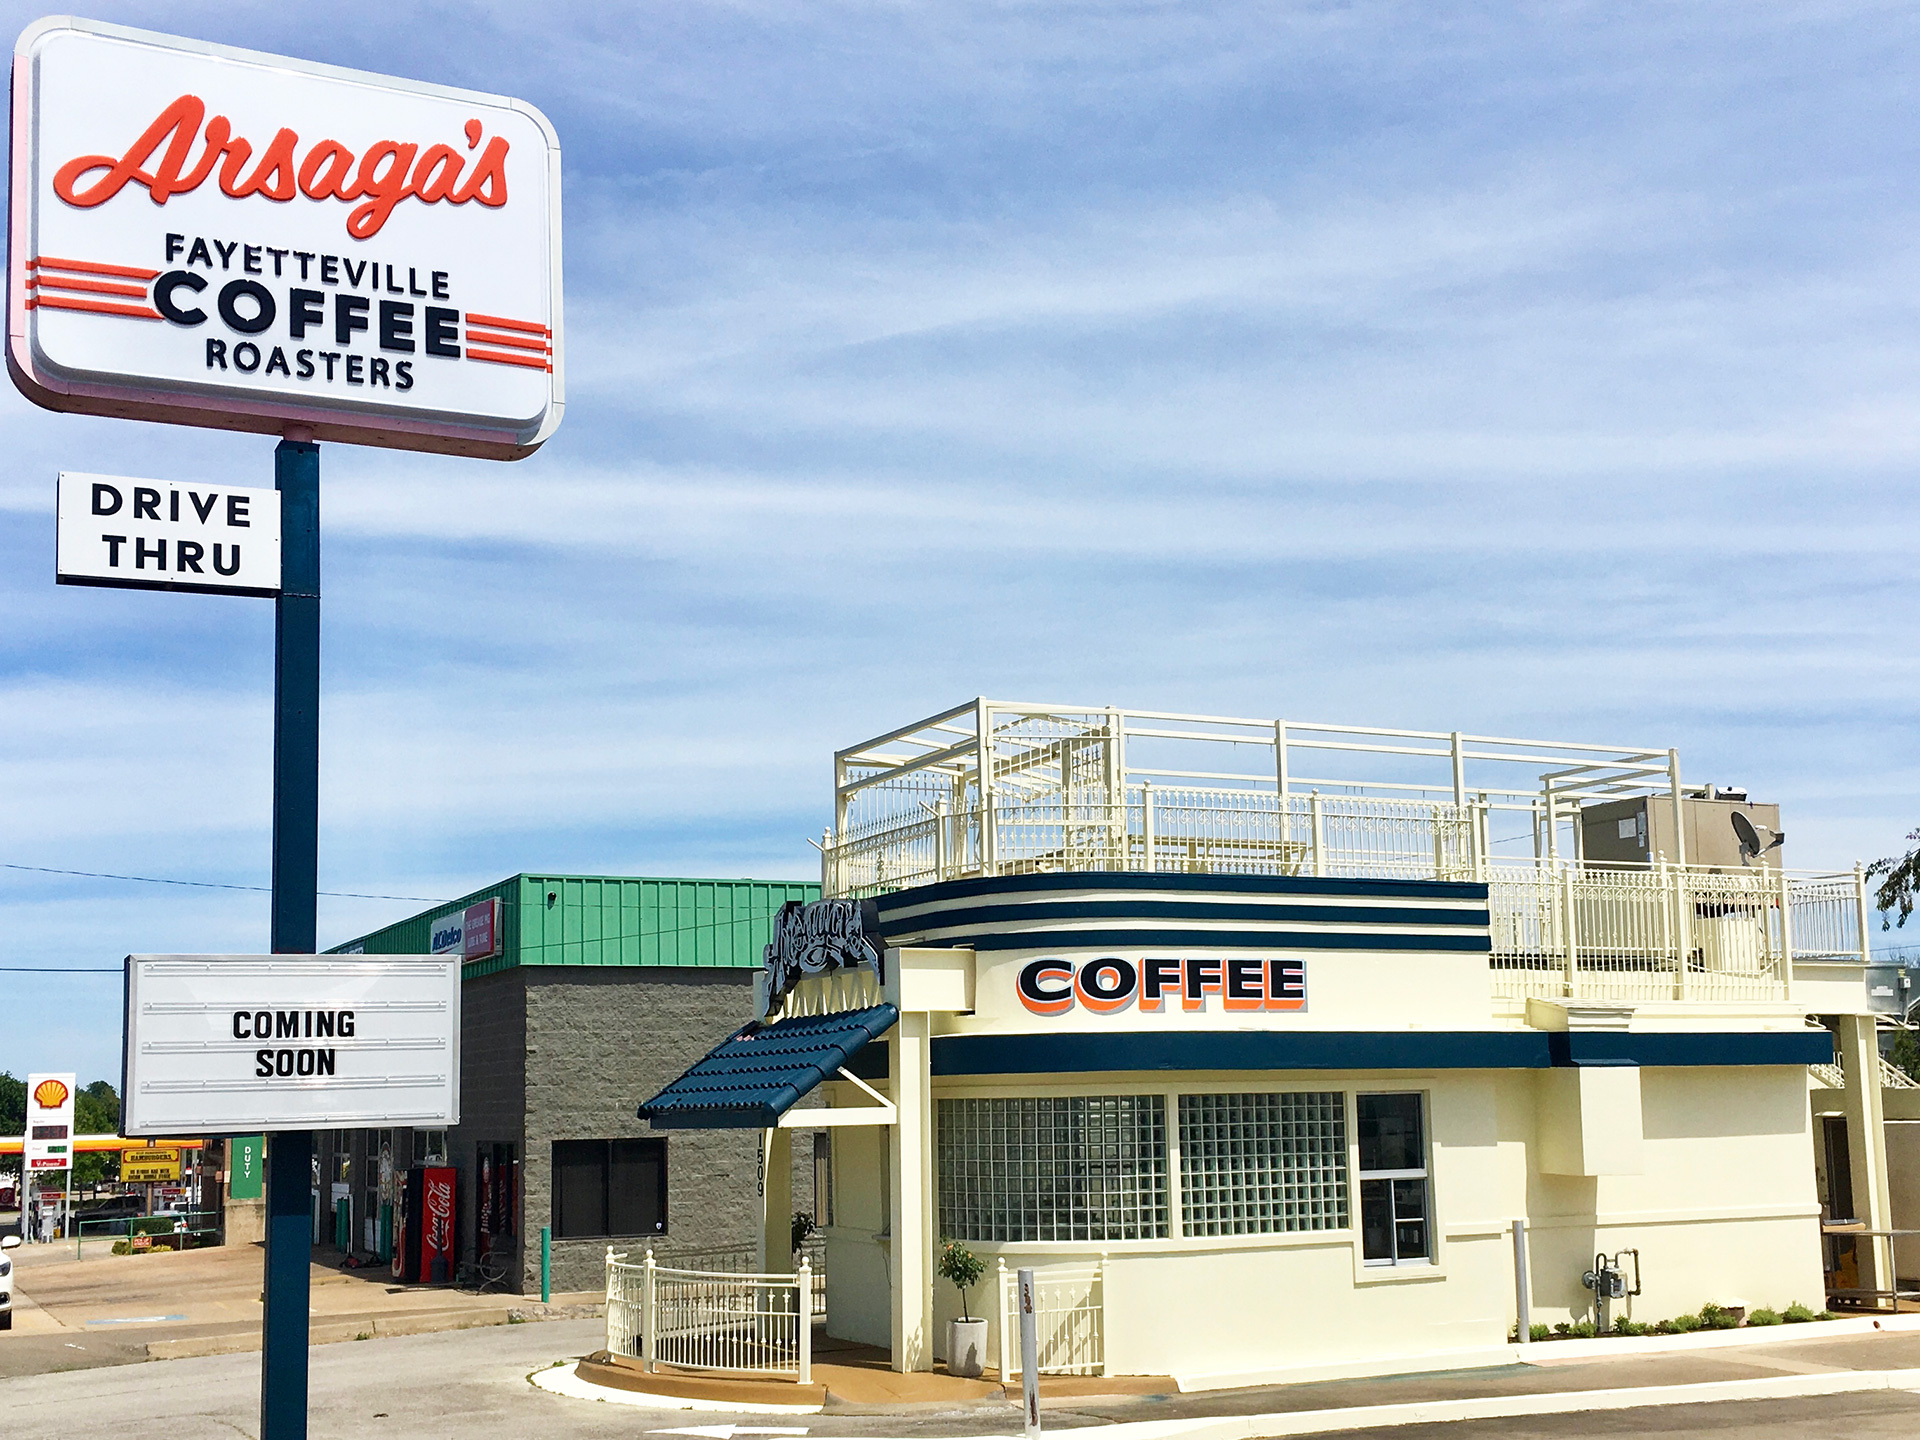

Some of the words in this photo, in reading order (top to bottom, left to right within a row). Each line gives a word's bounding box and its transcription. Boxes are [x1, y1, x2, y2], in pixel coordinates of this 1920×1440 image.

[53, 94, 511, 239] Arsaga's
[165, 232, 450, 300] FAYETTEVILLE
[153, 269, 462, 359] COFFEE
[206, 338, 415, 390] ROASTERS
[91, 482, 251, 528] DRIVE
[101, 534, 241, 577] THRU
[432, 926, 462, 952] ACDelco
[1016, 955, 1308, 1018] COFFEE
[233, 1010, 355, 1039] COMING
[255, 1048, 336, 1078] SOON
[244, 1146, 252, 1179] DUTY
